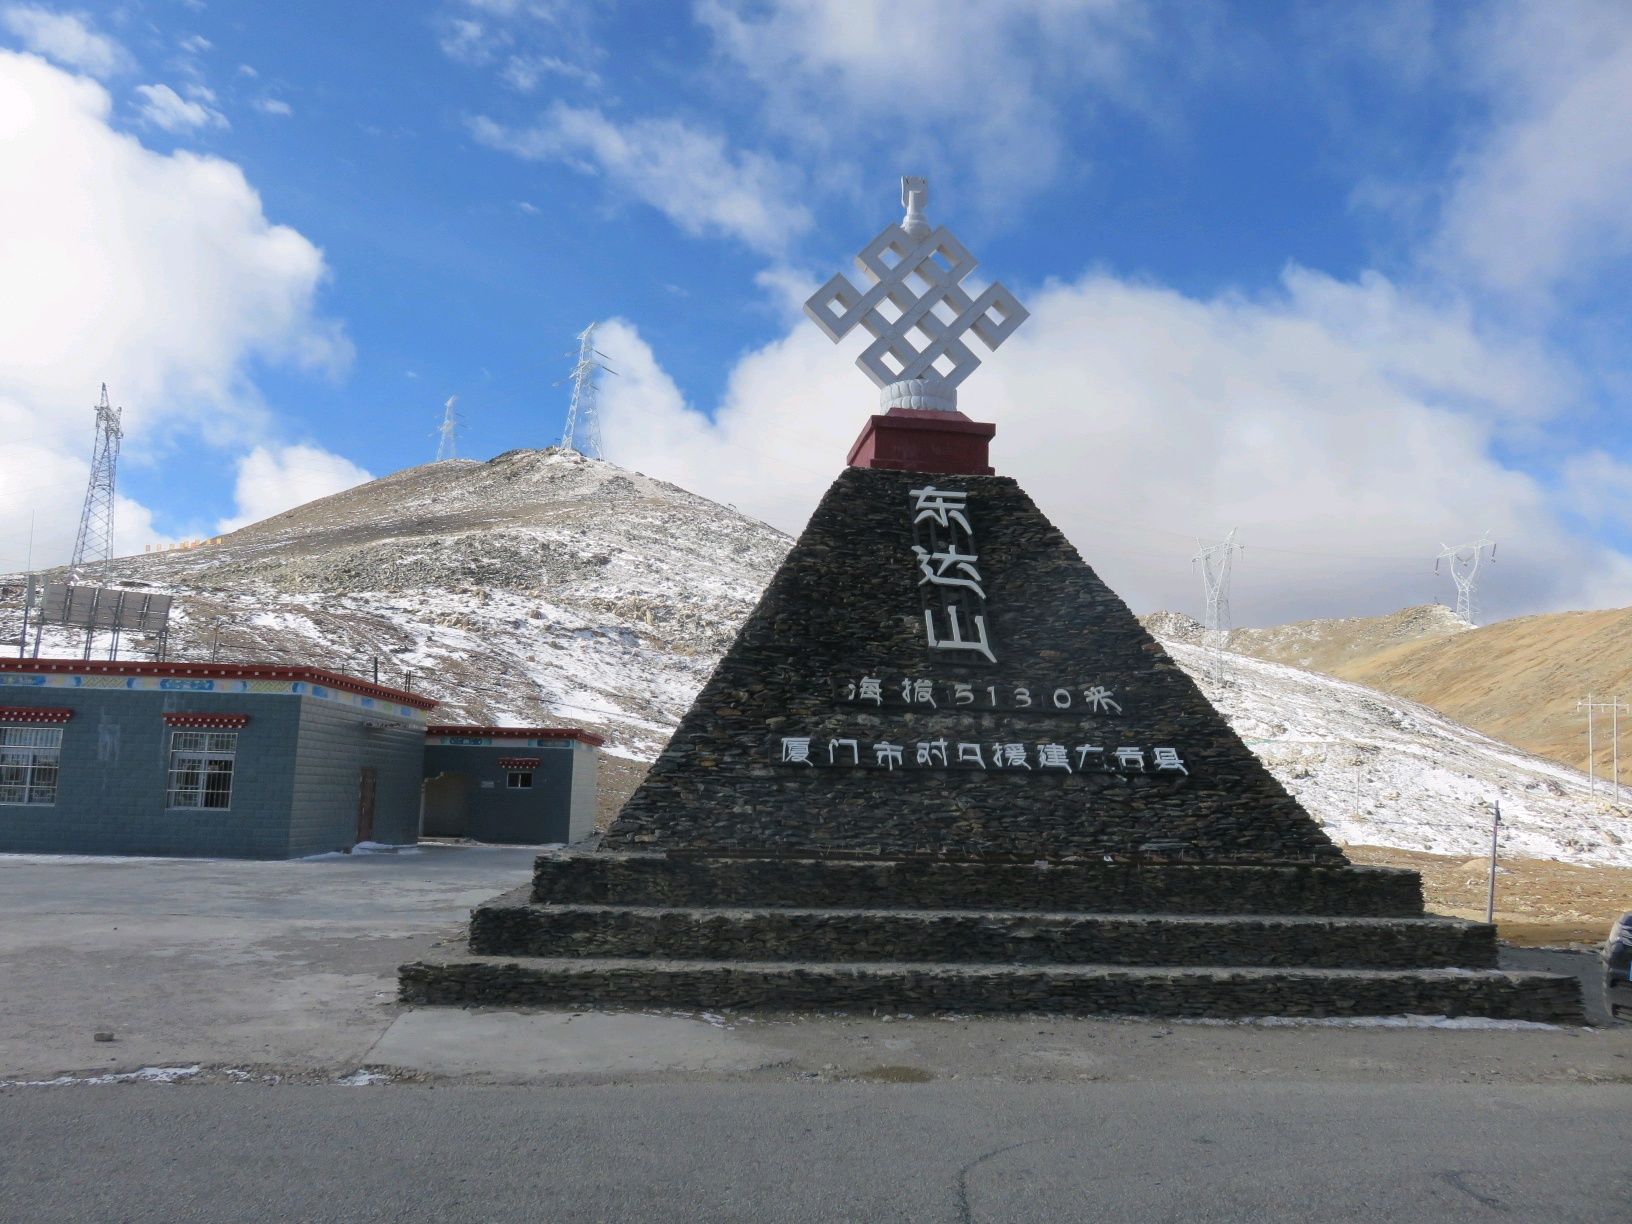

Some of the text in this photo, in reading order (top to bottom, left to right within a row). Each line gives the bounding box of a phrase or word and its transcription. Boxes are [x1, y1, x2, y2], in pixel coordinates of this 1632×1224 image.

[909, 486, 998, 663] 东达山
[847, 676, 1122, 715] 海拔5130米
